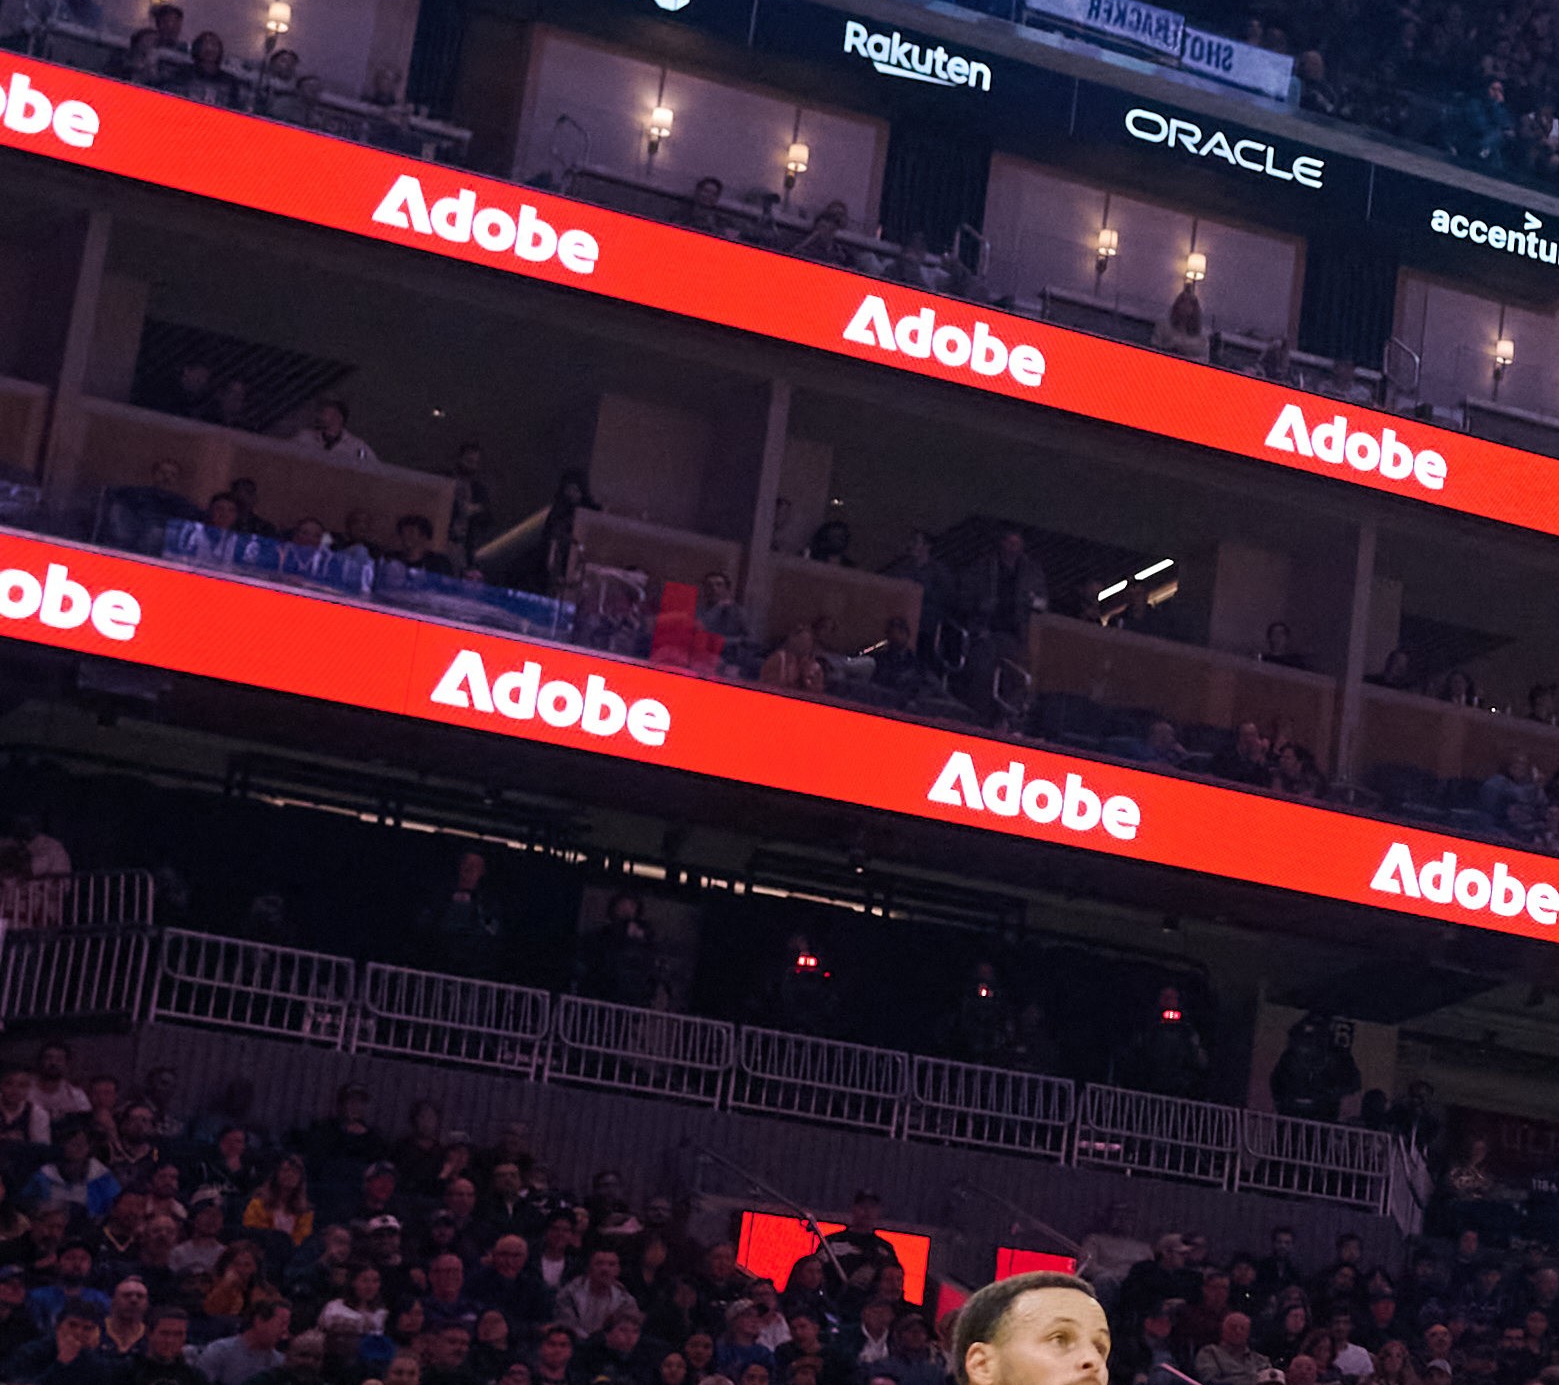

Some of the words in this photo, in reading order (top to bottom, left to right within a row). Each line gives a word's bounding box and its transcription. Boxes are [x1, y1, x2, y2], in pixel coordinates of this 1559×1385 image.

[843, 20, 991, 91] Rakuten
[1125, 108, 1325, 189] ORACLE
[371, 174, 600, 274] Adobe
[843, 295, 1046, 387] Adobe
[1265, 404, 1448, 490] Adobe
[430, 649, 671, 747] Adobe
[926, 751, 1141, 840] Adobe
